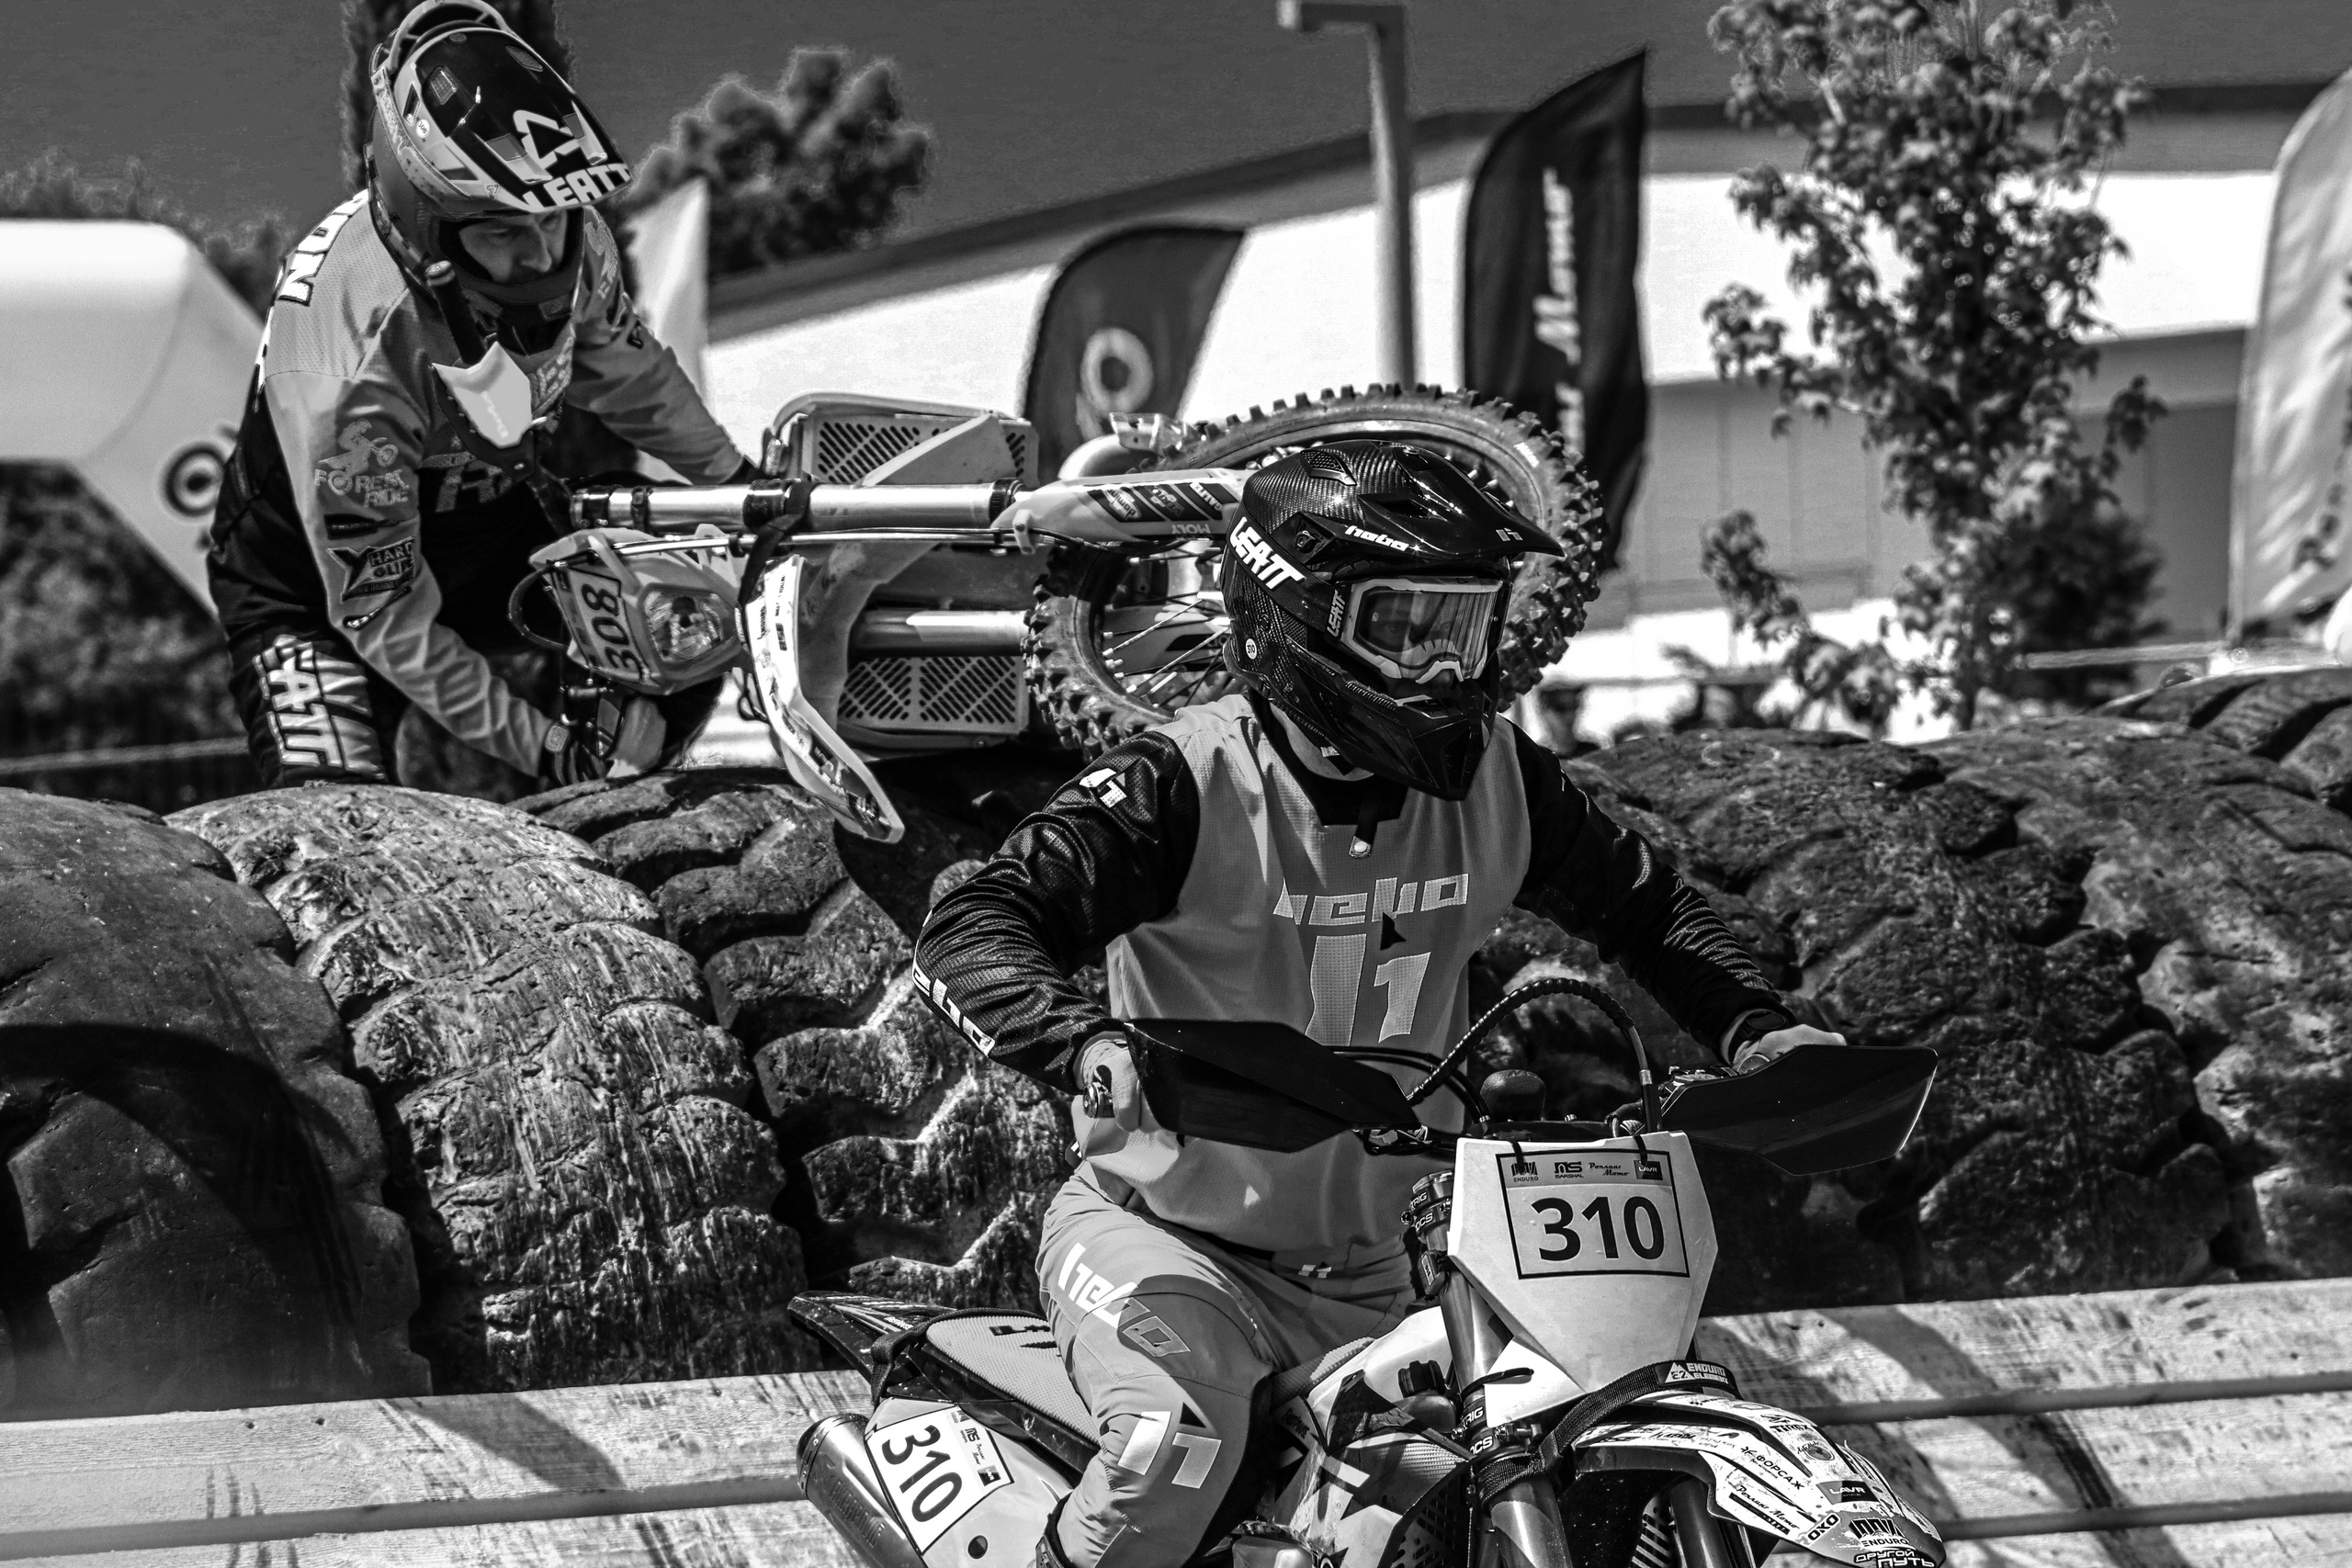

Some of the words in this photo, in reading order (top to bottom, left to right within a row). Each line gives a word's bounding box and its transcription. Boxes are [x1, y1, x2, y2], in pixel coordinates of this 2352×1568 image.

[522, 163, 632, 212] LEATT
[1171, 524, 1212, 535] MOLY
[1229, 516, 1308, 590] LEATT
[1326, 589, 1347, 637] LEATT
[582, 583, 642, 681] 308
[1247, 644, 1256, 654] 310
[911, 955, 996, 1057] ebo
[1531, 1195, 1665, 1261] 310
[1686, 1362, 1726, 1377] ENDURO
[881, 1425, 963, 1523] 310
[1756, 1454, 1805, 1490] ФОРСАЖ
[1828, 1486, 1867, 1495] LAVR
[1855, 1549, 1916, 1563] ДРУГОЙ
[1860, 1536, 1910, 1548] ENDURO
[1877, 1556, 1936, 1568] ПУТЬ
